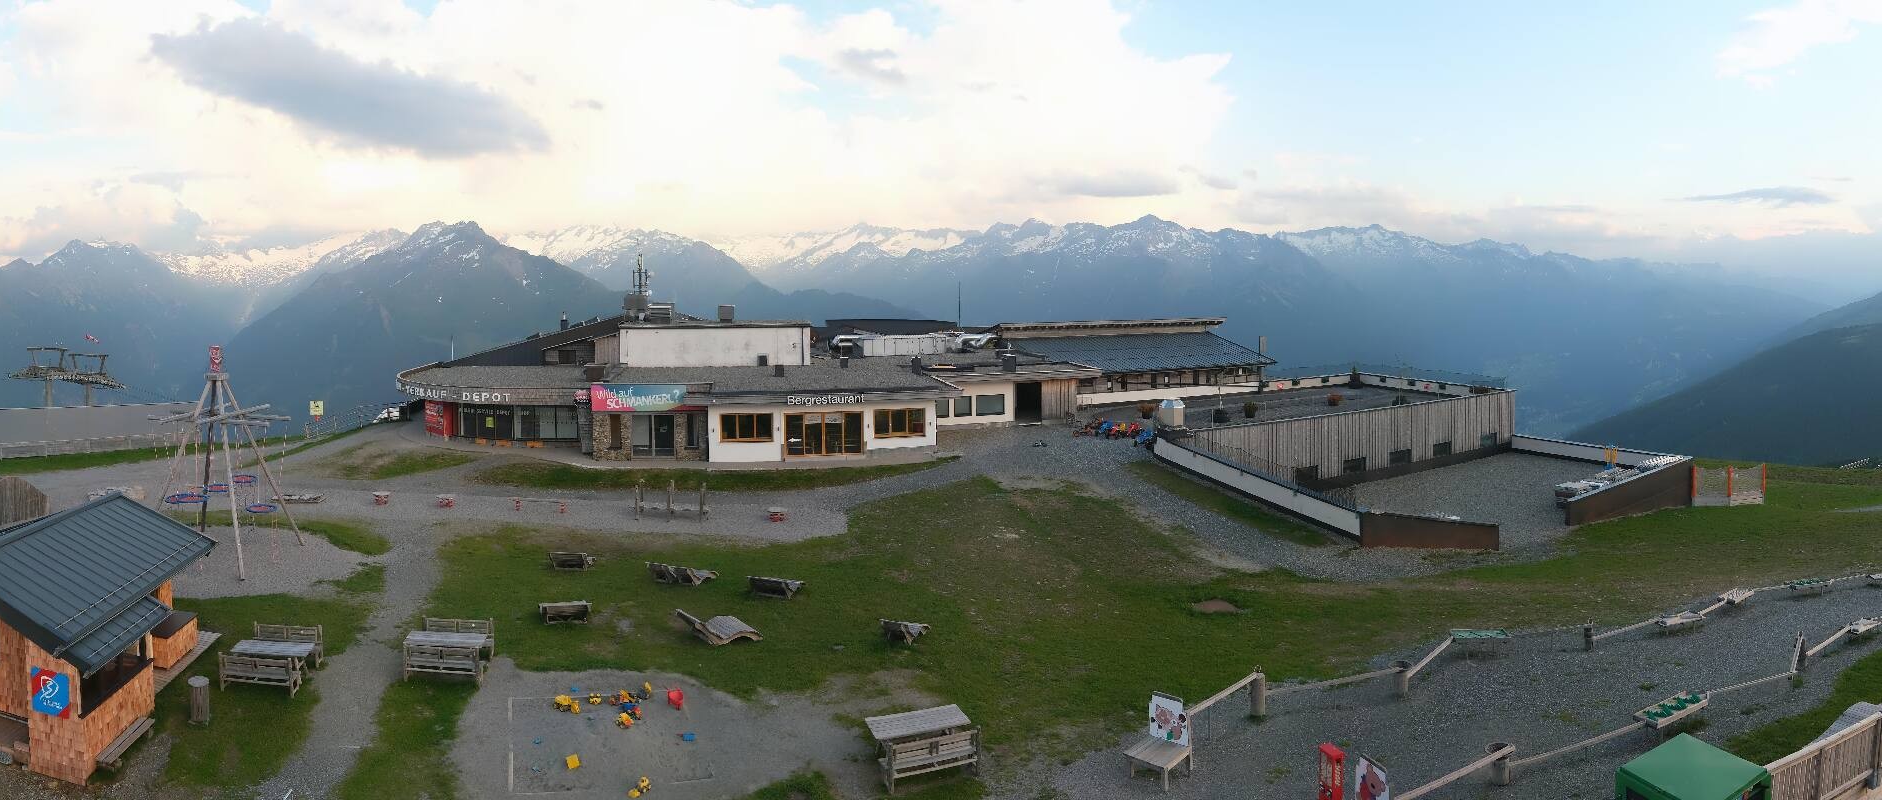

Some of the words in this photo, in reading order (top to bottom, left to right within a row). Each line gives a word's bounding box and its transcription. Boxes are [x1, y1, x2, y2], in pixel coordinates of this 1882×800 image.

[405, 385, 447, 398] VERKAUF
[462, 392, 511, 402] DEPOT
[596, 388, 616, 399] Wild
[618, 386, 634, 398] auf
[606, 389, 680, 409] SCHMANKERL?
[787, 394, 865, 406] Bergrestaurant
